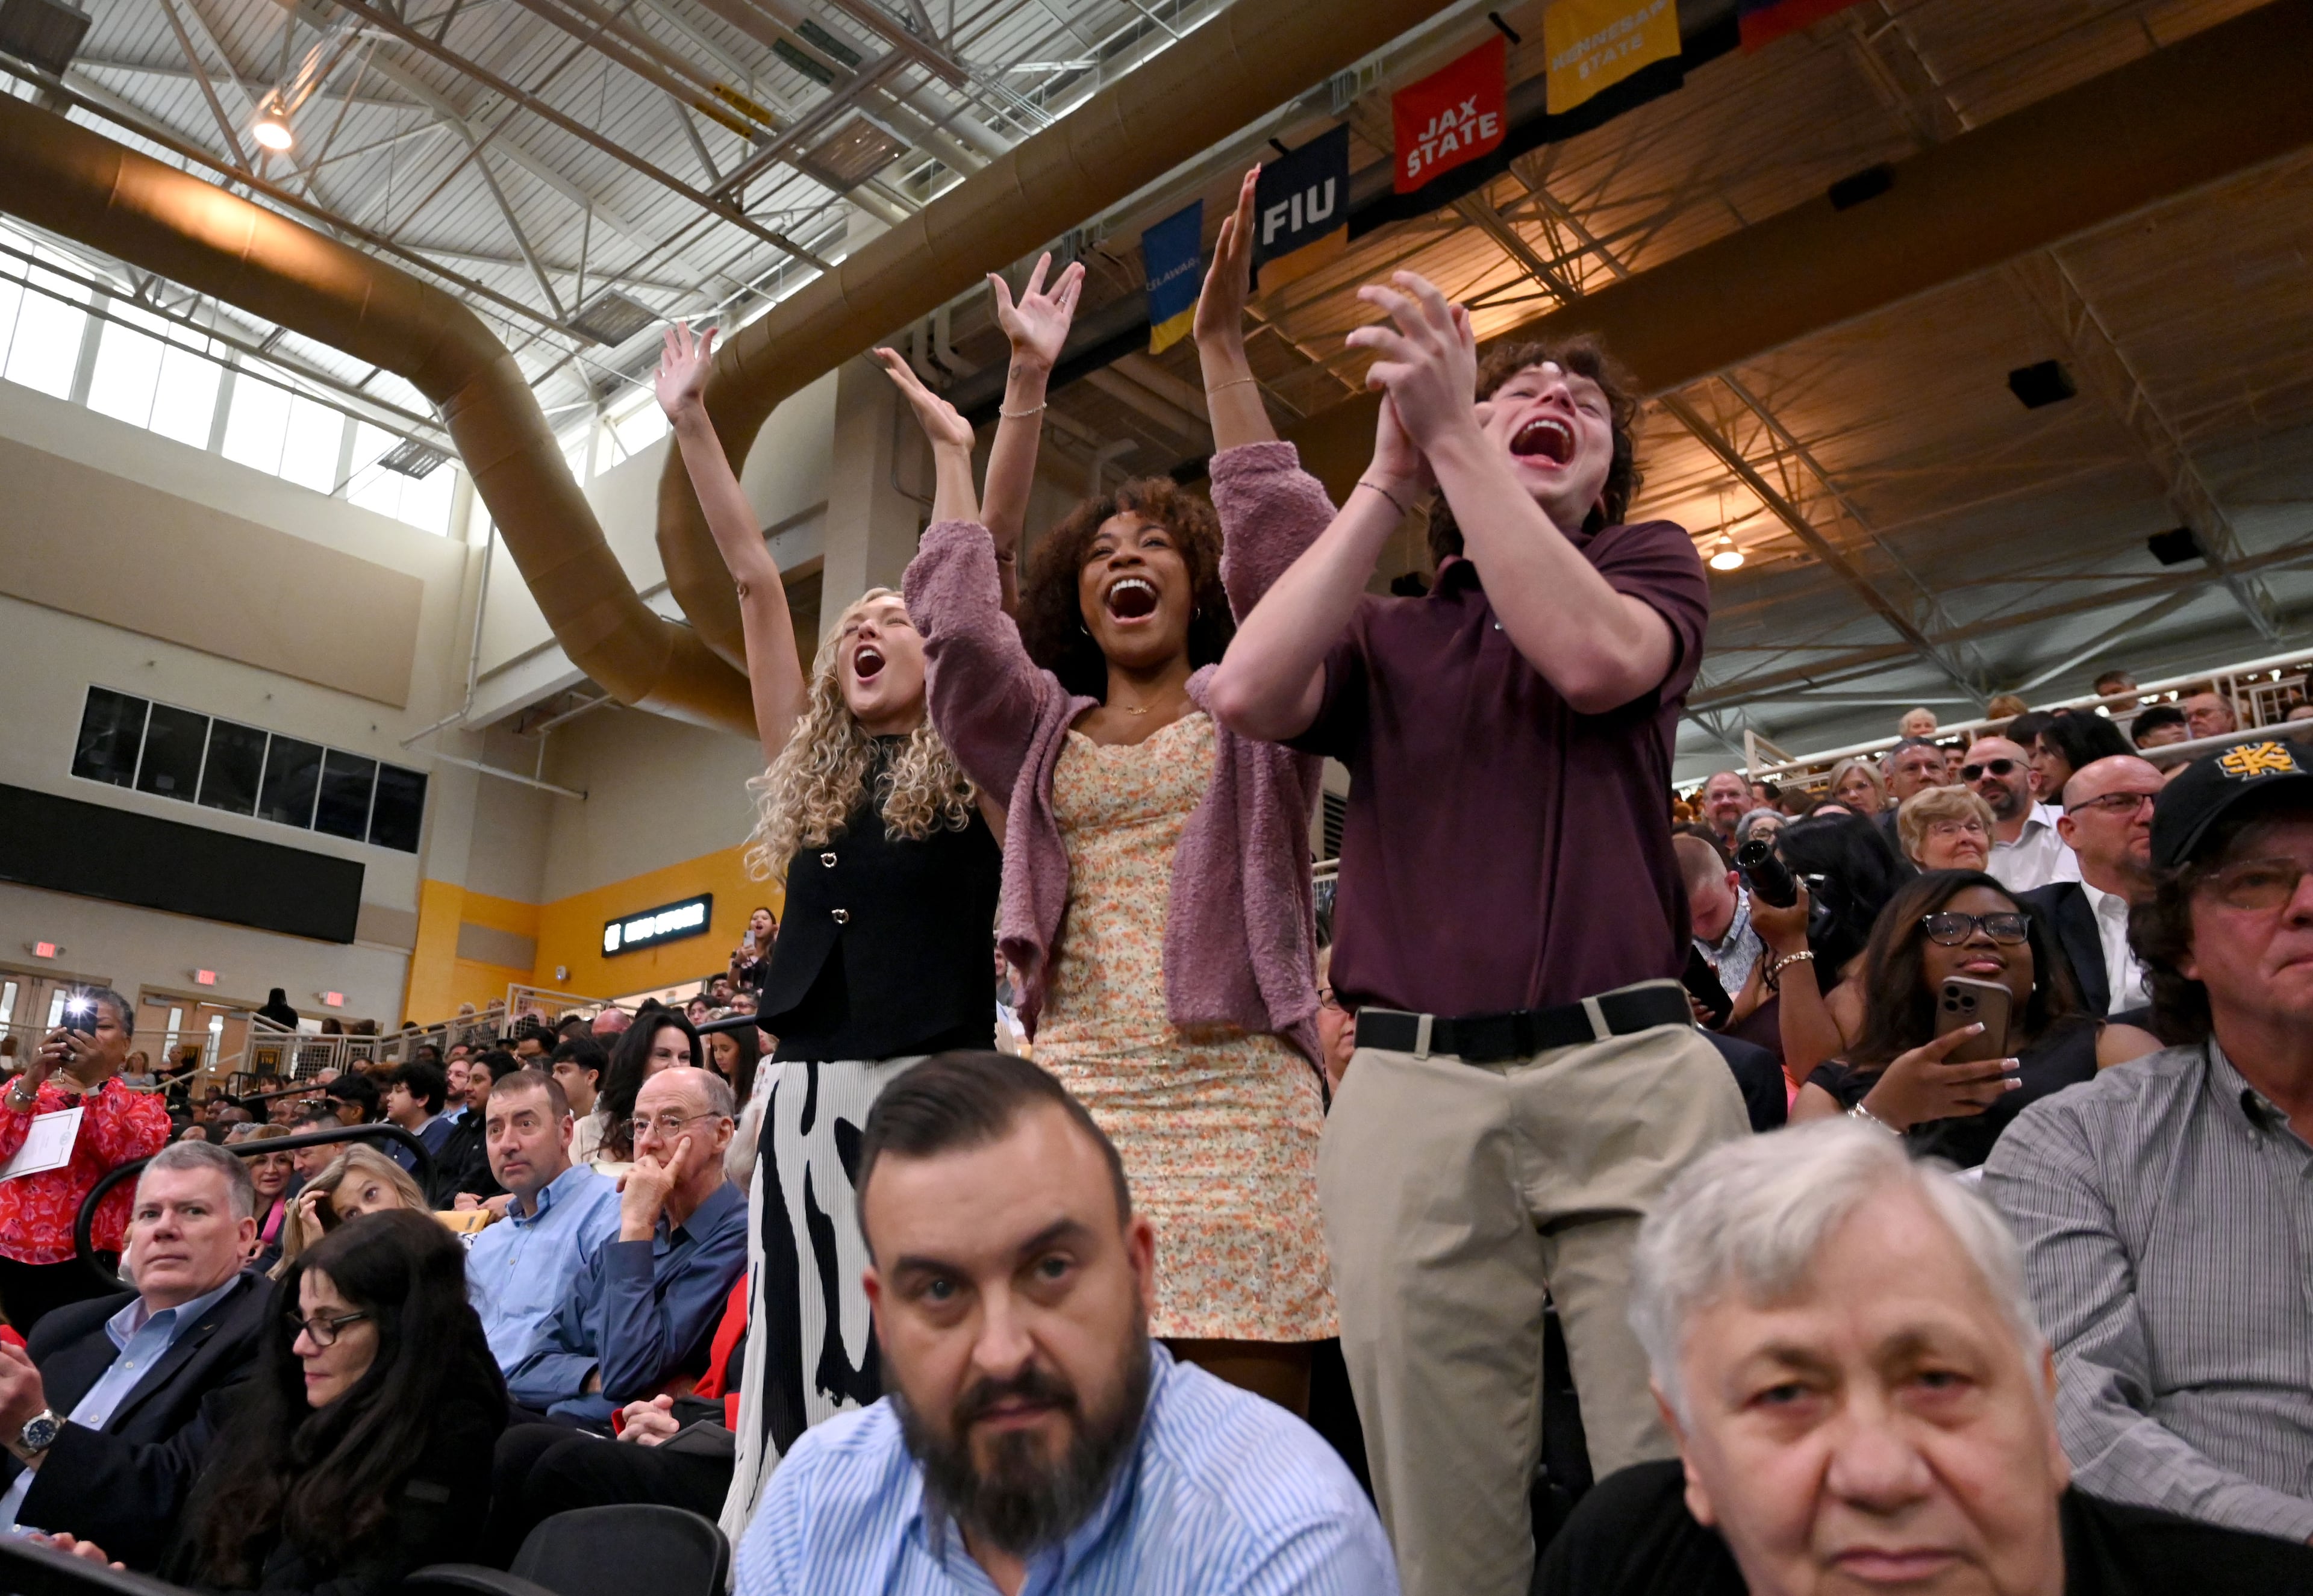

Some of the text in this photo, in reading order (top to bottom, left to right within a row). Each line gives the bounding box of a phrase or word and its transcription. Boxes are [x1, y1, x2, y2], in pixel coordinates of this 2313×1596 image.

[1579, 33, 1643, 80] STATE
[1407, 111, 1499, 178] STATE
[1418, 93, 1478, 142] JAX
[1263, 176, 1335, 245] FIU
